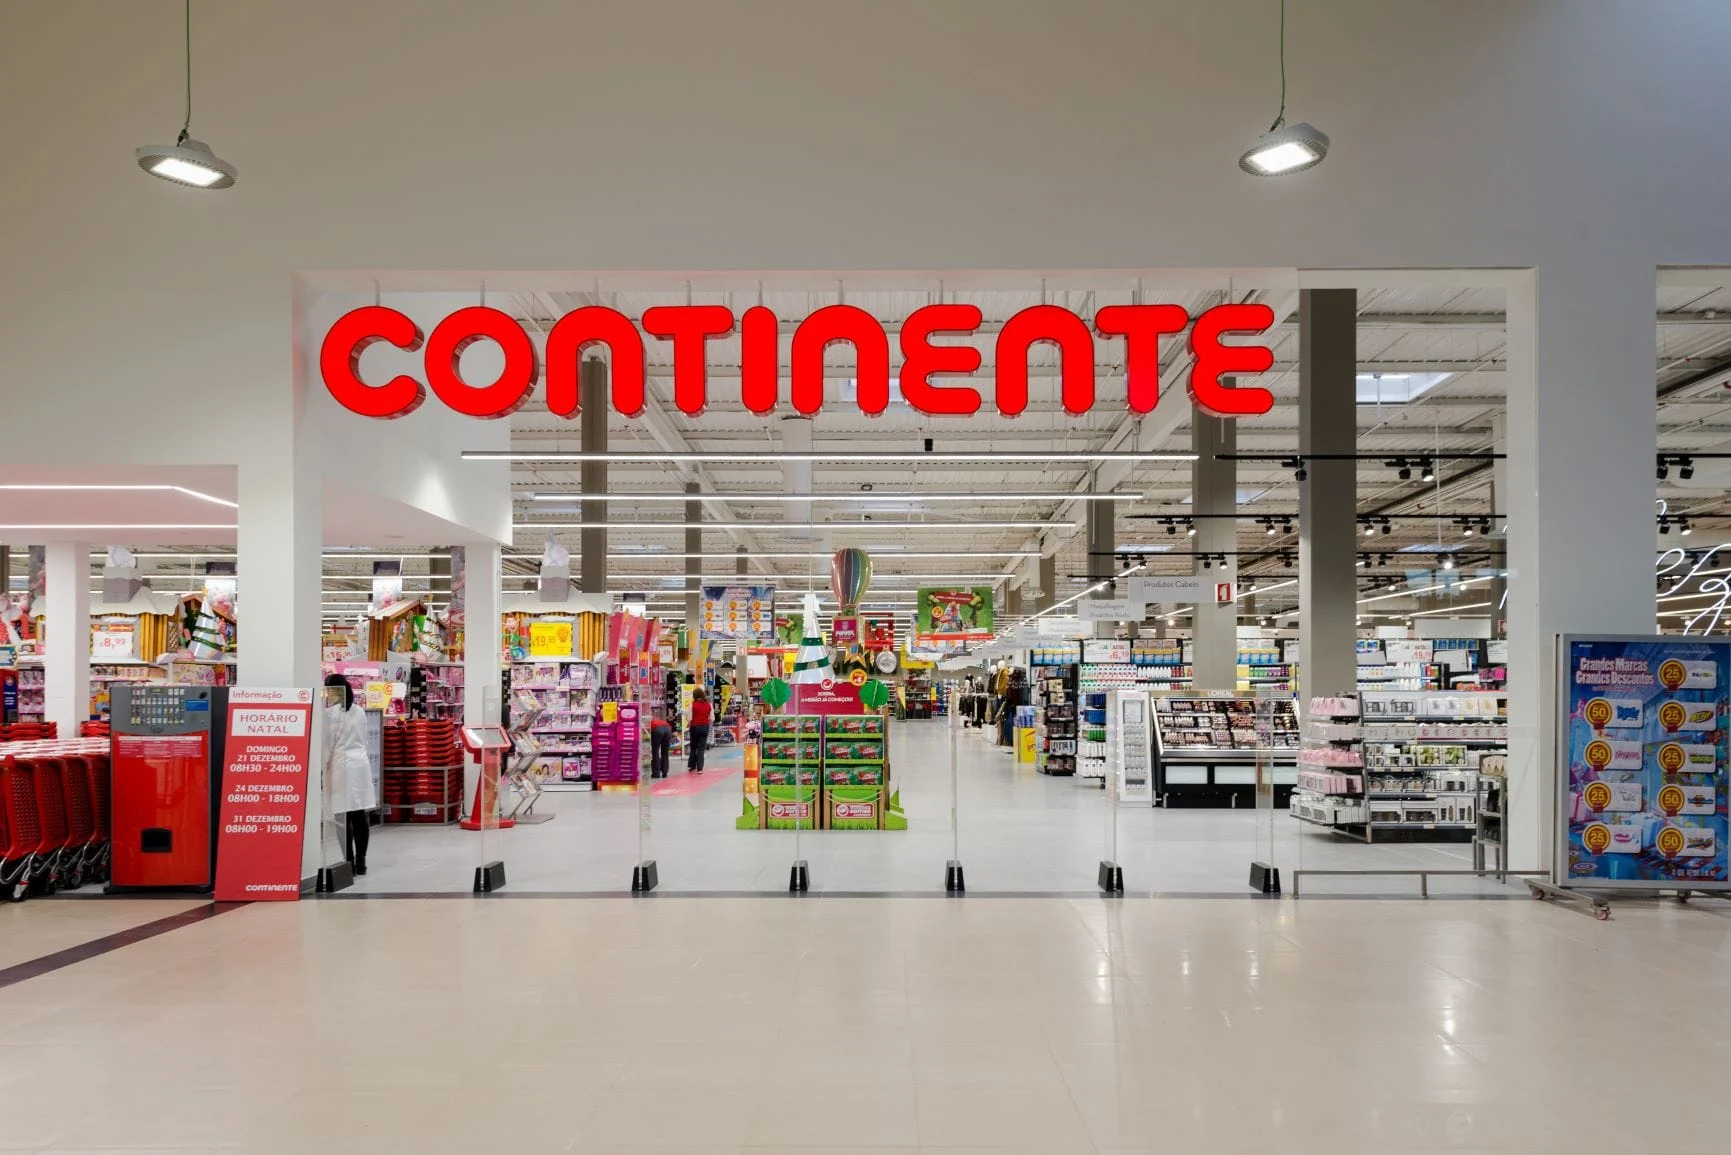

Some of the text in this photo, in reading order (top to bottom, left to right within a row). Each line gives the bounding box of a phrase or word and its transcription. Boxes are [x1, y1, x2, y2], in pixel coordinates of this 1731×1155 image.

[320, 304, 1274, 417] CONTINENTE
[1143, 580, 1200, 588] Produtos Cabelo
[1615, 658, 1648, 672] Marcas
[1611, 671, 1655, 685] Descontos
[232, 690, 283, 700] Informação
[240, 713, 298, 723] HORÁRIO
[247, 725, 289, 734] NATAL
[246, 745, 288, 753] DOMINGO
[237, 754, 296, 762] 21 DEZEMBRO
[230, 763, 262, 773] 08H30
[269, 763, 302, 773] 24H00
[235, 784, 294, 793] 24 DEZEMBRO
[227, 794, 260, 803] 08H00
[268, 794, 300, 803] 18H00
[233, 815, 292, 823] 31 DEZEMBRO
[225, 824, 258, 834] 08H00
[266, 824, 298, 834] 19H00
[245, 884, 299, 892] CONTINENTE
